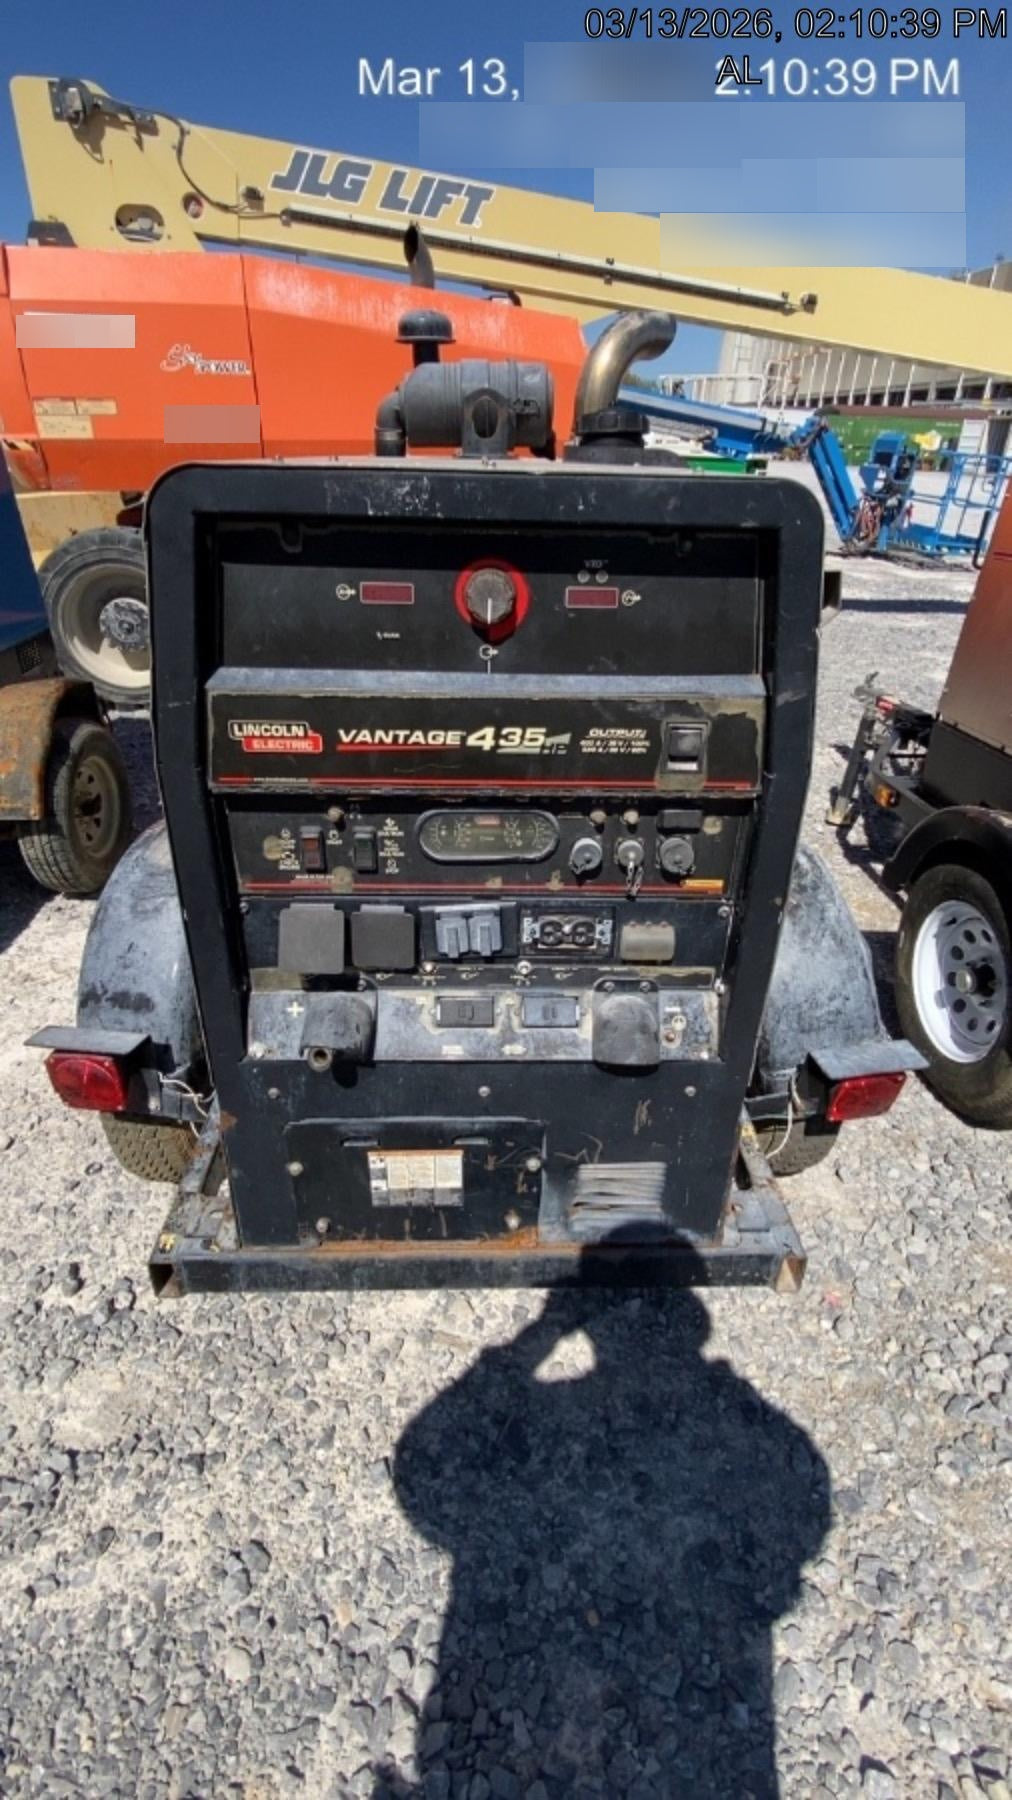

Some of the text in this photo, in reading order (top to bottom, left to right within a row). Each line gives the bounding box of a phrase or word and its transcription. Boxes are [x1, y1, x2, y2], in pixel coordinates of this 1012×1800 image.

[269, 148, 495, 227] JLG LIFT
[232, 723, 305, 737] LINCOLN
[338, 729, 461, 745] VANTAGE
[466, 727, 547, 751] 435
[252, 739, 314, 750] ELECTRIC
